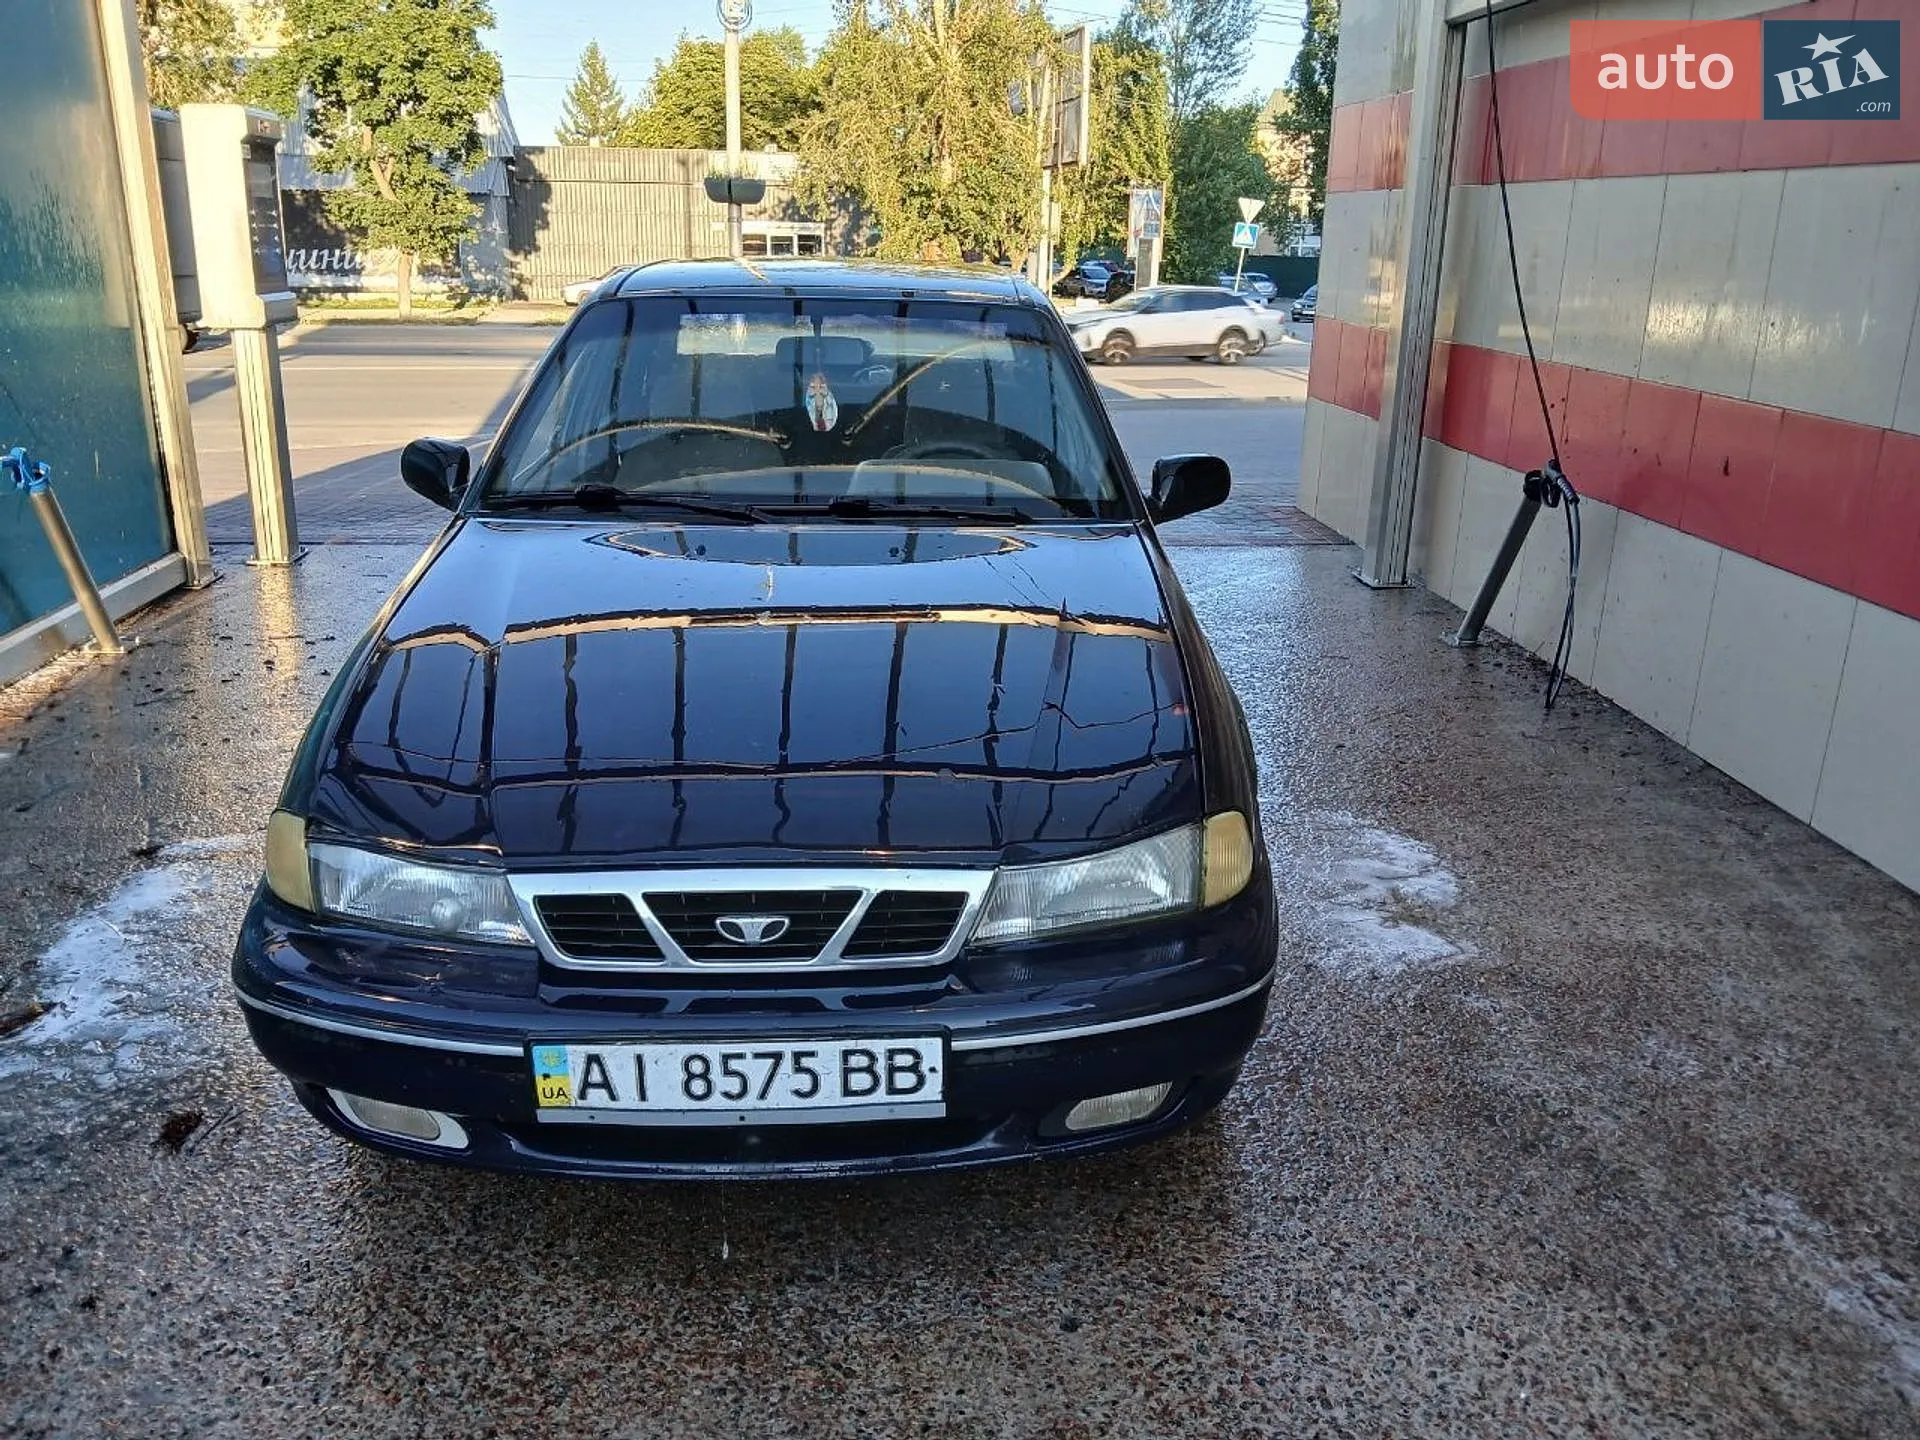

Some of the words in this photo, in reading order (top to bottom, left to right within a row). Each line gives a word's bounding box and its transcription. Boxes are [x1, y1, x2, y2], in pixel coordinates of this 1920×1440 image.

[577, 1053, 647, 1102] AI
[681, 1050, 821, 1101] 8575
[839, 1046, 928, 1099] BB
[542, 1086, 568, 1100] UA
